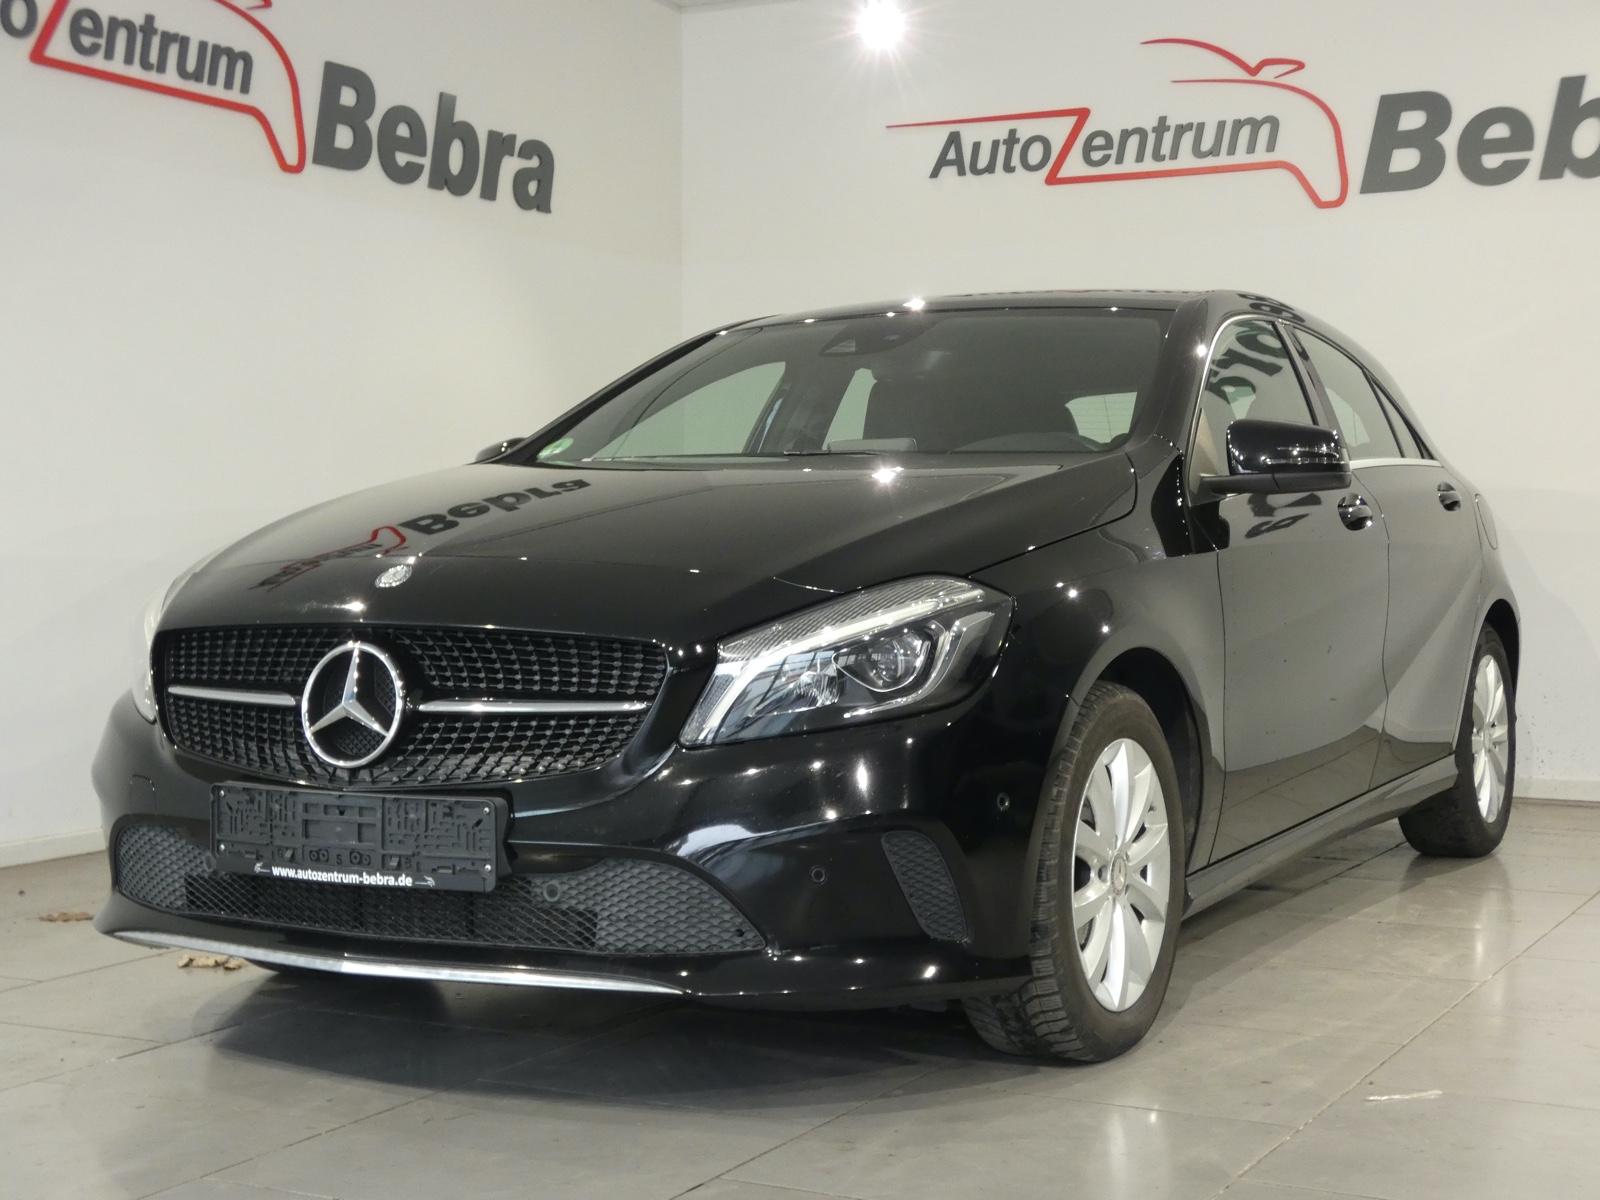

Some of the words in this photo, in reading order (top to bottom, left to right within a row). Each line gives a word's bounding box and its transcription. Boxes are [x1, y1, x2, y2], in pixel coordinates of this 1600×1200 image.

[312, 60, 555, 214] Bebra
[929, 107, 1281, 185] AutoZentrum
[1359, 74, 1600, 195] Beb
[271, 865, 413, 887] www.autozentrum-bebra.de
